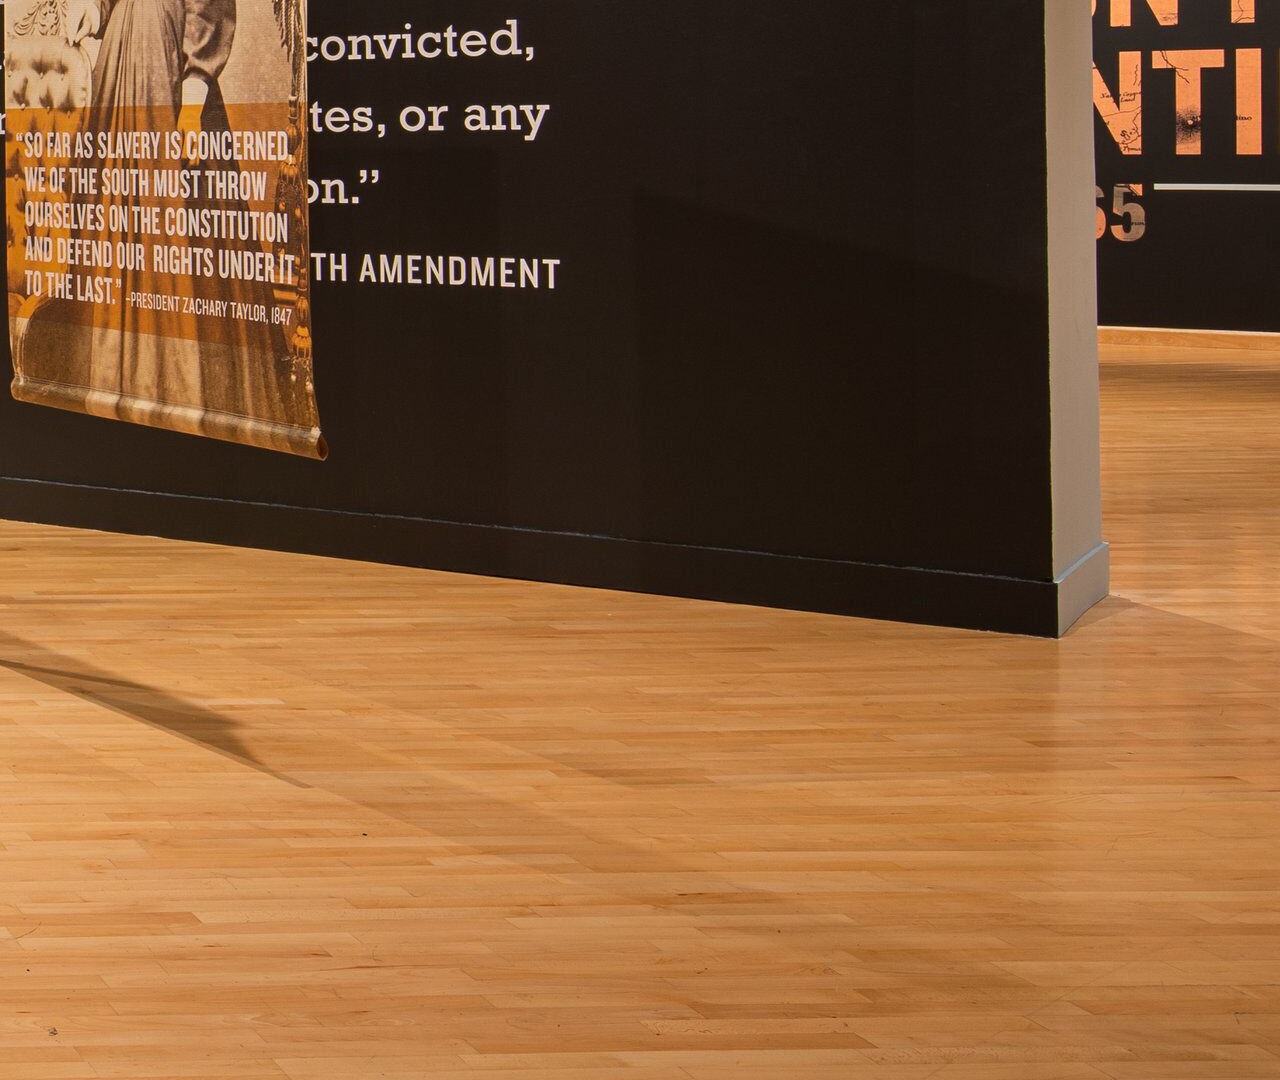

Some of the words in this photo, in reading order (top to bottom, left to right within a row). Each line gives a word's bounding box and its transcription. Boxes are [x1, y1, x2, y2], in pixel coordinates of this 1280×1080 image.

[306, 19, 535, 62] convicted,
[309, 99, 387, 138] tes,
[399, 103, 448, 133] or
[463, 102, 550, 142] any
[15, 131, 43, 158] “SO
[47, 131, 71, 158] FAR
[74, 131, 94, 159] AS
[97, 131, 161, 160] SLAVERY
[165, 131, 181, 160] IS
[186, 130, 293, 165] CONCERNED,
[24, 167, 46, 193] WE
[49, 167, 66, 194] OF
[69, 167, 98, 195] THE
[101, 167, 150, 197] SOUTH
[153, 169, 201, 199] MUST
[205, 170, 267, 201] THROW
[24, 200, 105, 232] OURSELVES
[109, 204, 129, 233] ON
[131, 205, 161, 235] THE
[165, 207, 288, 243] CONSTITUTION
[24, 236, 53, 263] AND
[57, 237, 113, 268] DEFEND
[116, 241, 146, 271] OUR
[153, 244, 214, 277] RIGHTS
[218, 249, 275, 283] UNDER
[279, 253, 295, 285] IT
[311, 252, 347, 282] TH
[358, 253, 561, 289] AMENDMENT
[24, 270, 42, 297] TO
[45, 272, 73, 300] THE
[77, 275, 122, 304] LAST.”
[182, 297, 228, 318] ZACHARY
[230, 301, 269, 325] TAYLOR,
[271, 307, 292, 326] 1847
